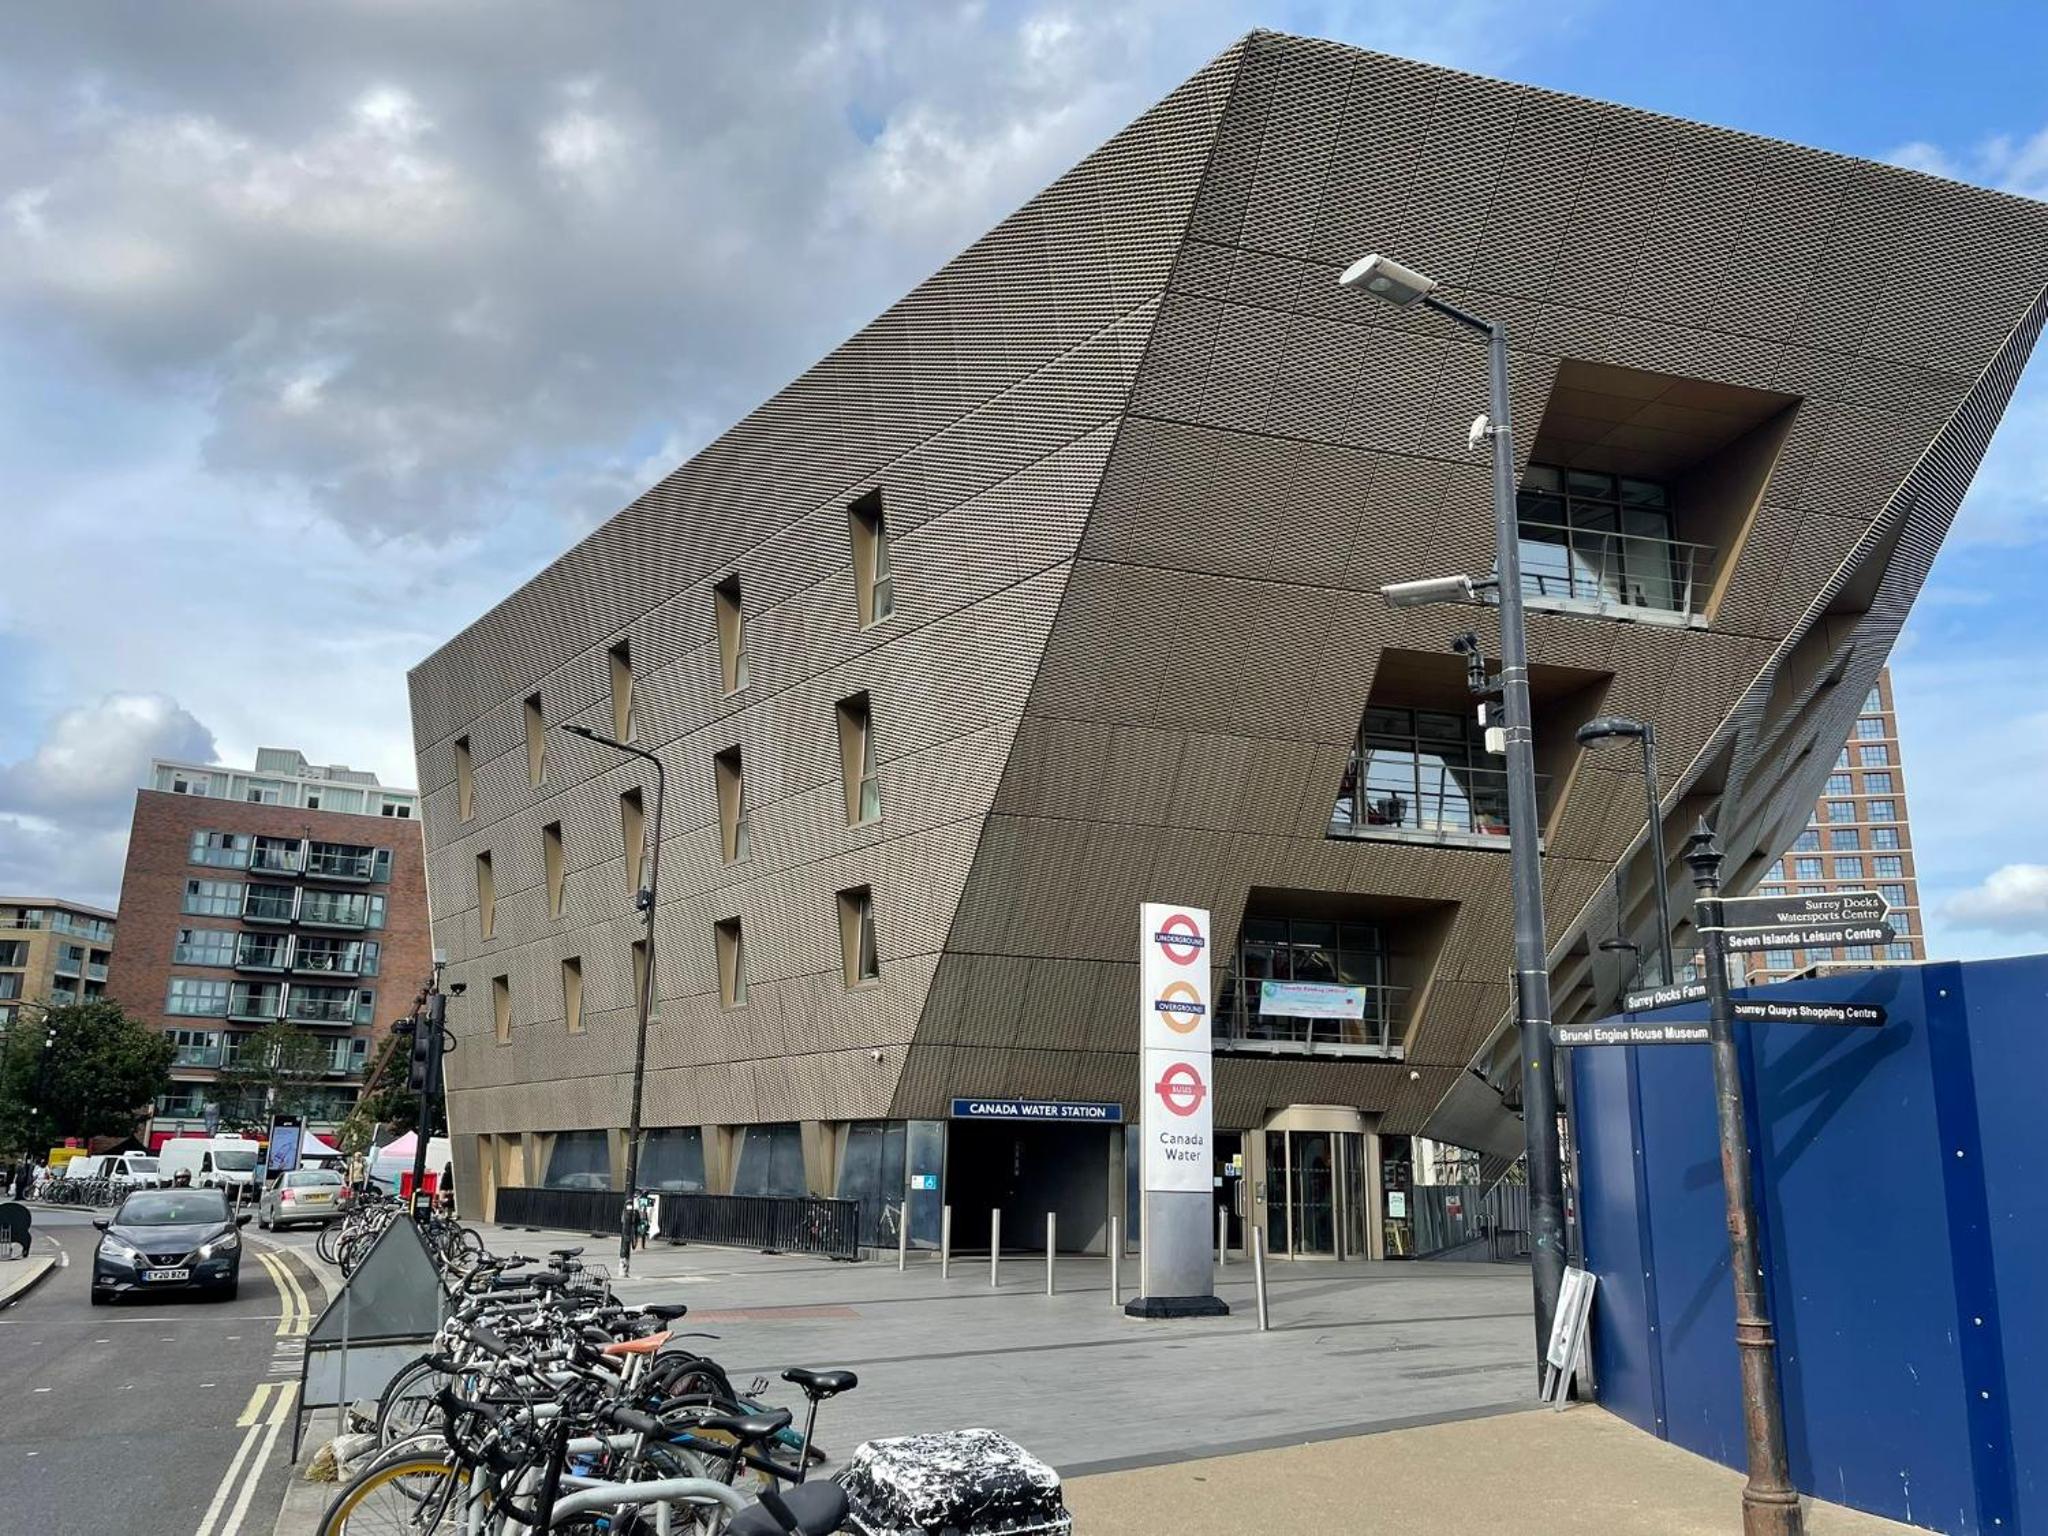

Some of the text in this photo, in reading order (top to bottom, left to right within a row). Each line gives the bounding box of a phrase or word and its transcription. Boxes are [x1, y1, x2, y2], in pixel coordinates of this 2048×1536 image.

[1805, 897, 1879, 912] Surrey Docks
[1776, 909, 1880, 923] Watersports Centre
[1156, 933, 1204, 946] UNDERGROUND
[1729, 928, 1882, 948] Seven Islands Leisure Centre
[1628, 985, 1706, 1008] Surrey Docks Farm
[1158, 1003, 1204, 1013] OVERGROUND
[1734, 1004, 1877, 1019] Surrey Quays Shopping Centre
[1559, 1027, 1709, 1043] Brunel Engine House Museum
[969, 1103, 1106, 1118] CANADA WATER STATION
[1160, 1132, 1204, 1145] Canada
[1165, 1148, 1201, 1161] Water
